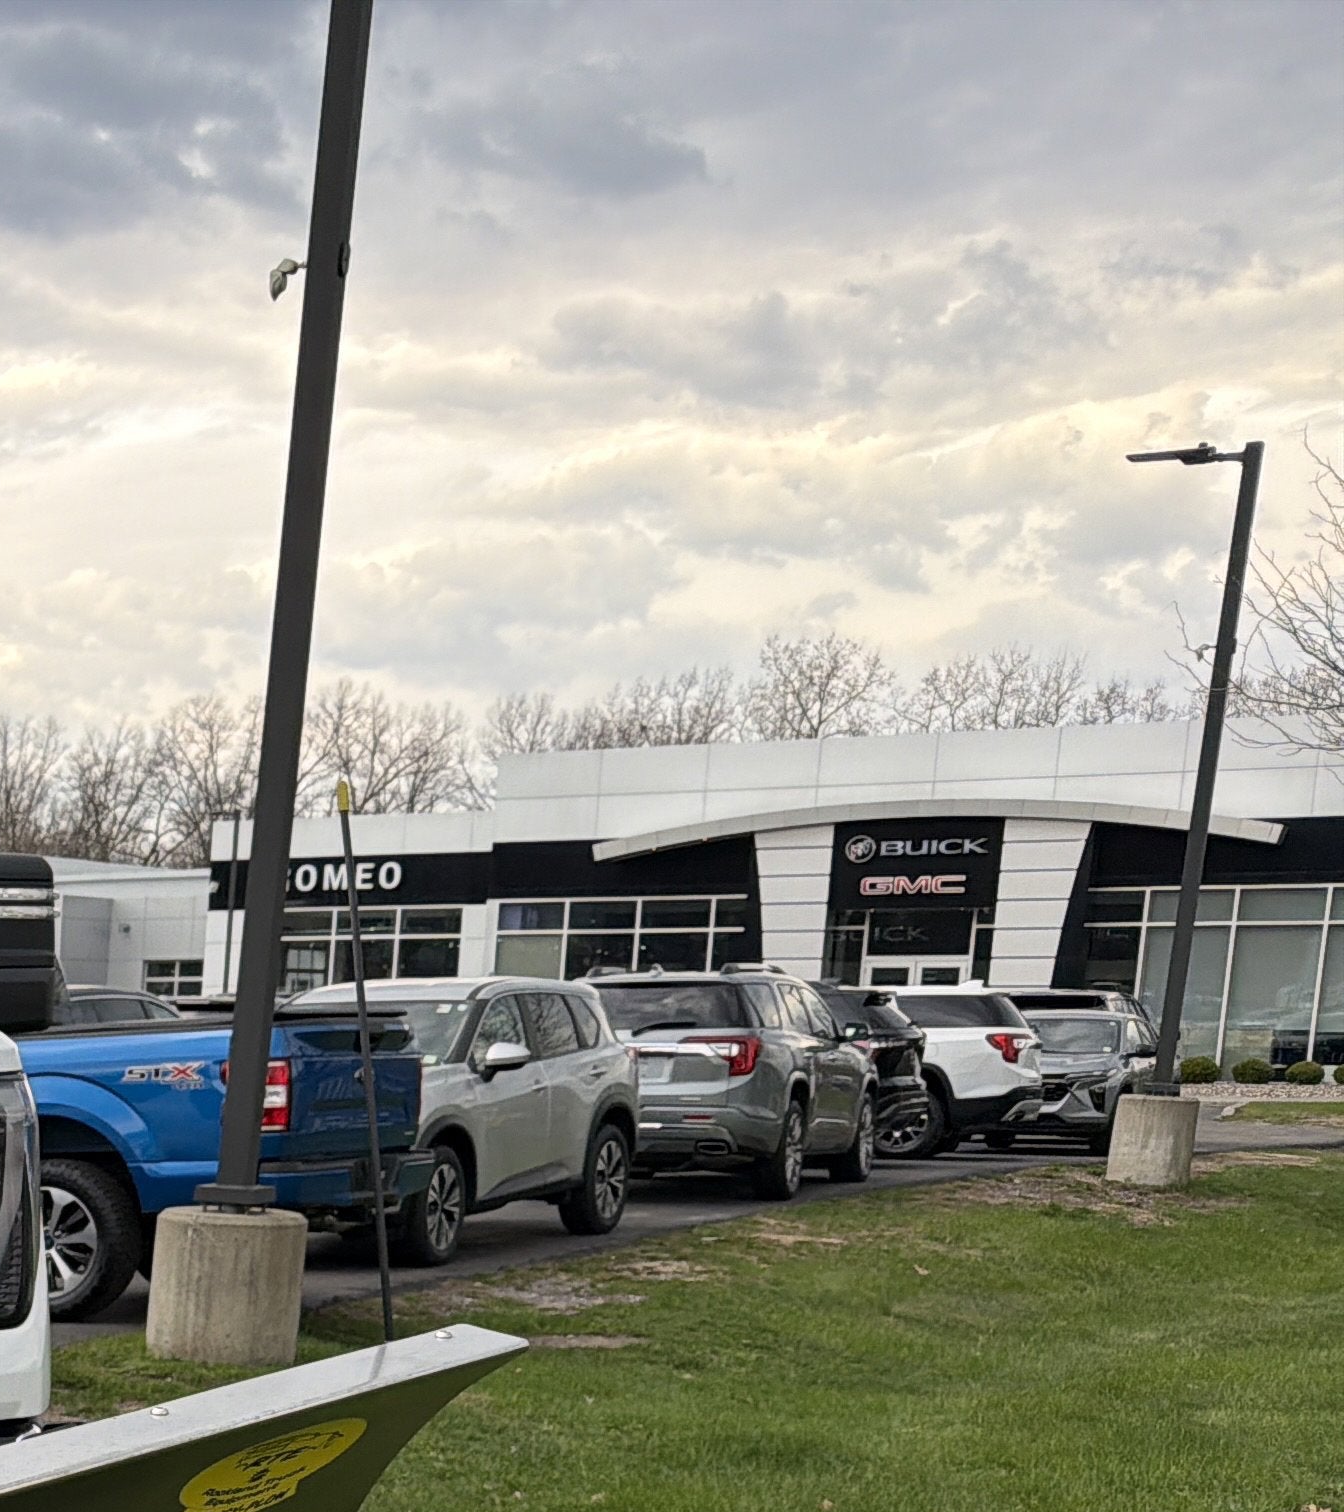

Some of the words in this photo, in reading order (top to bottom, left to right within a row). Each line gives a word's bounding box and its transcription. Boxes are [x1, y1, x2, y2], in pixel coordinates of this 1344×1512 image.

[879, 837, 990, 857] BUICK
[859, 874, 968, 896] GMC
[121, 1061, 205, 1084] STX
